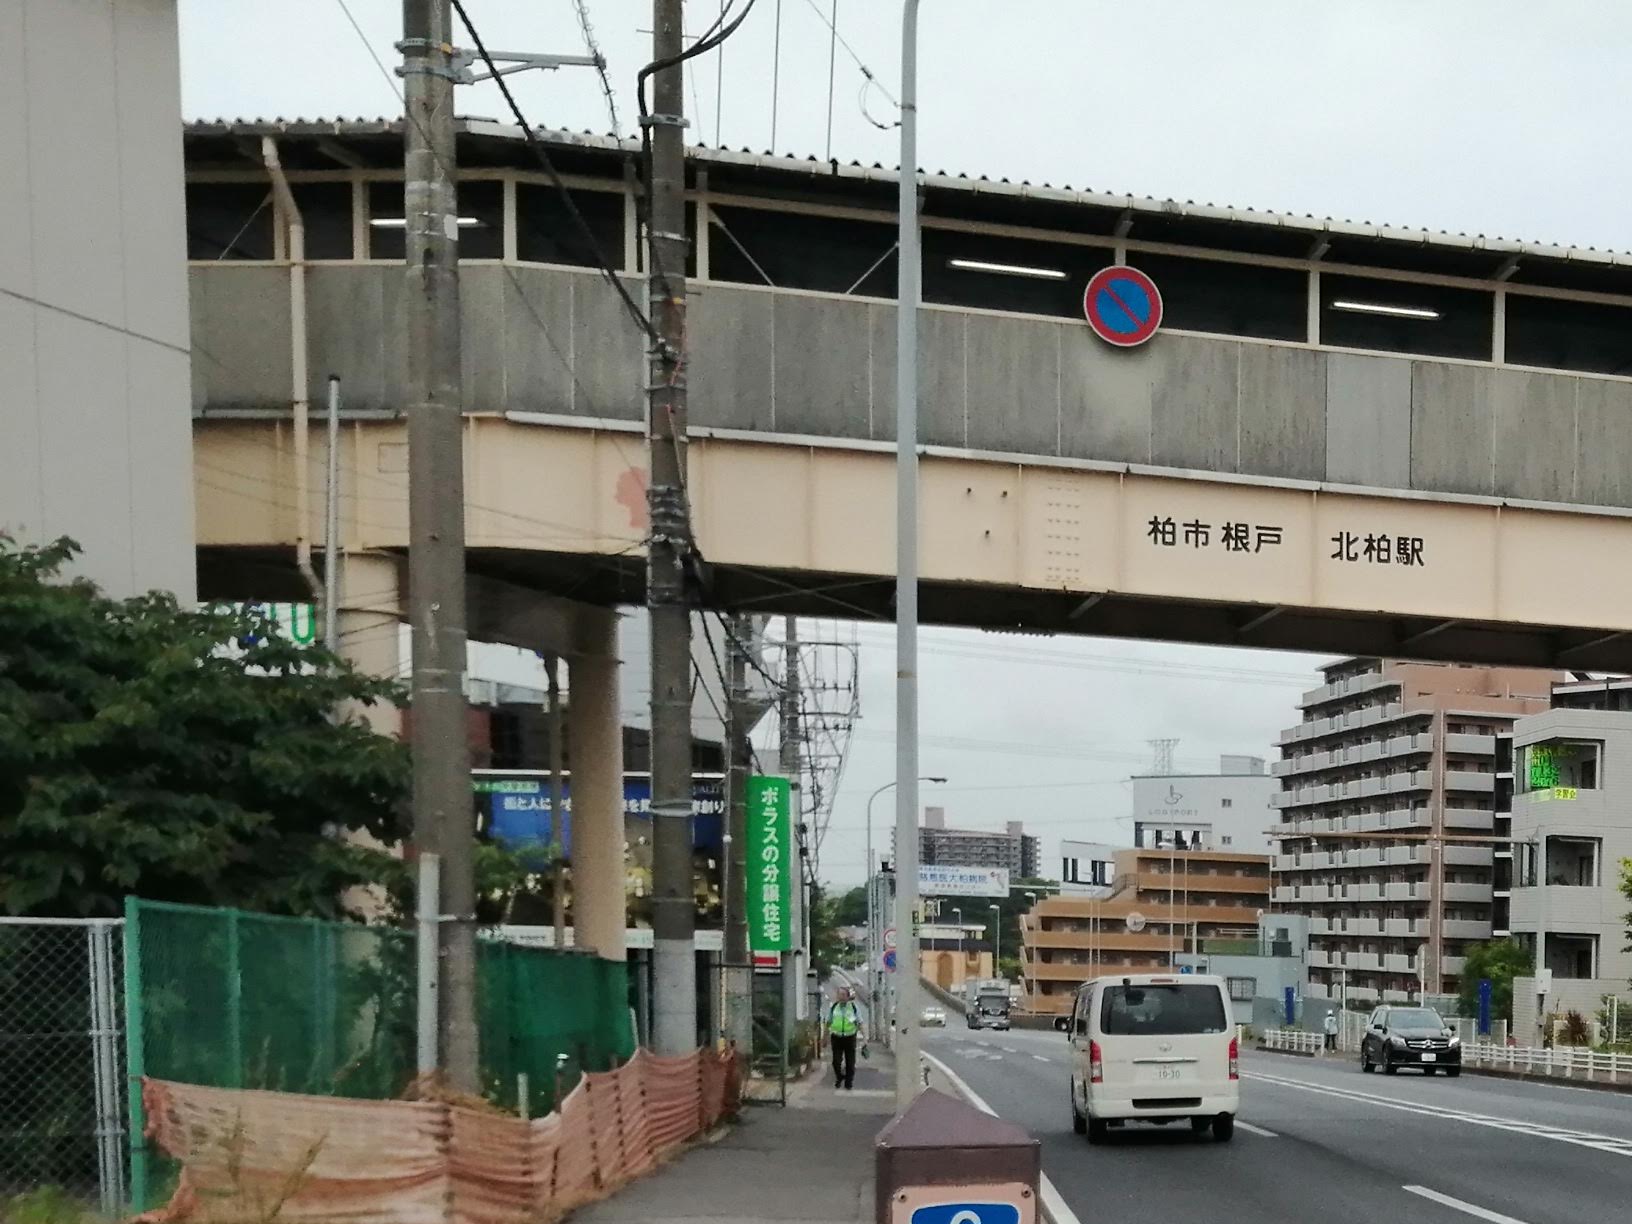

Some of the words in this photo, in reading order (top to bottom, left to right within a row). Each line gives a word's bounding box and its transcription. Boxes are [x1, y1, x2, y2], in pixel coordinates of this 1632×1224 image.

[1147, 515, 1283, 554] 柏市根戸
[1330, 530, 1424, 567] 北柏駅
[761, 786, 781, 942] ポラスの分譲住宅
